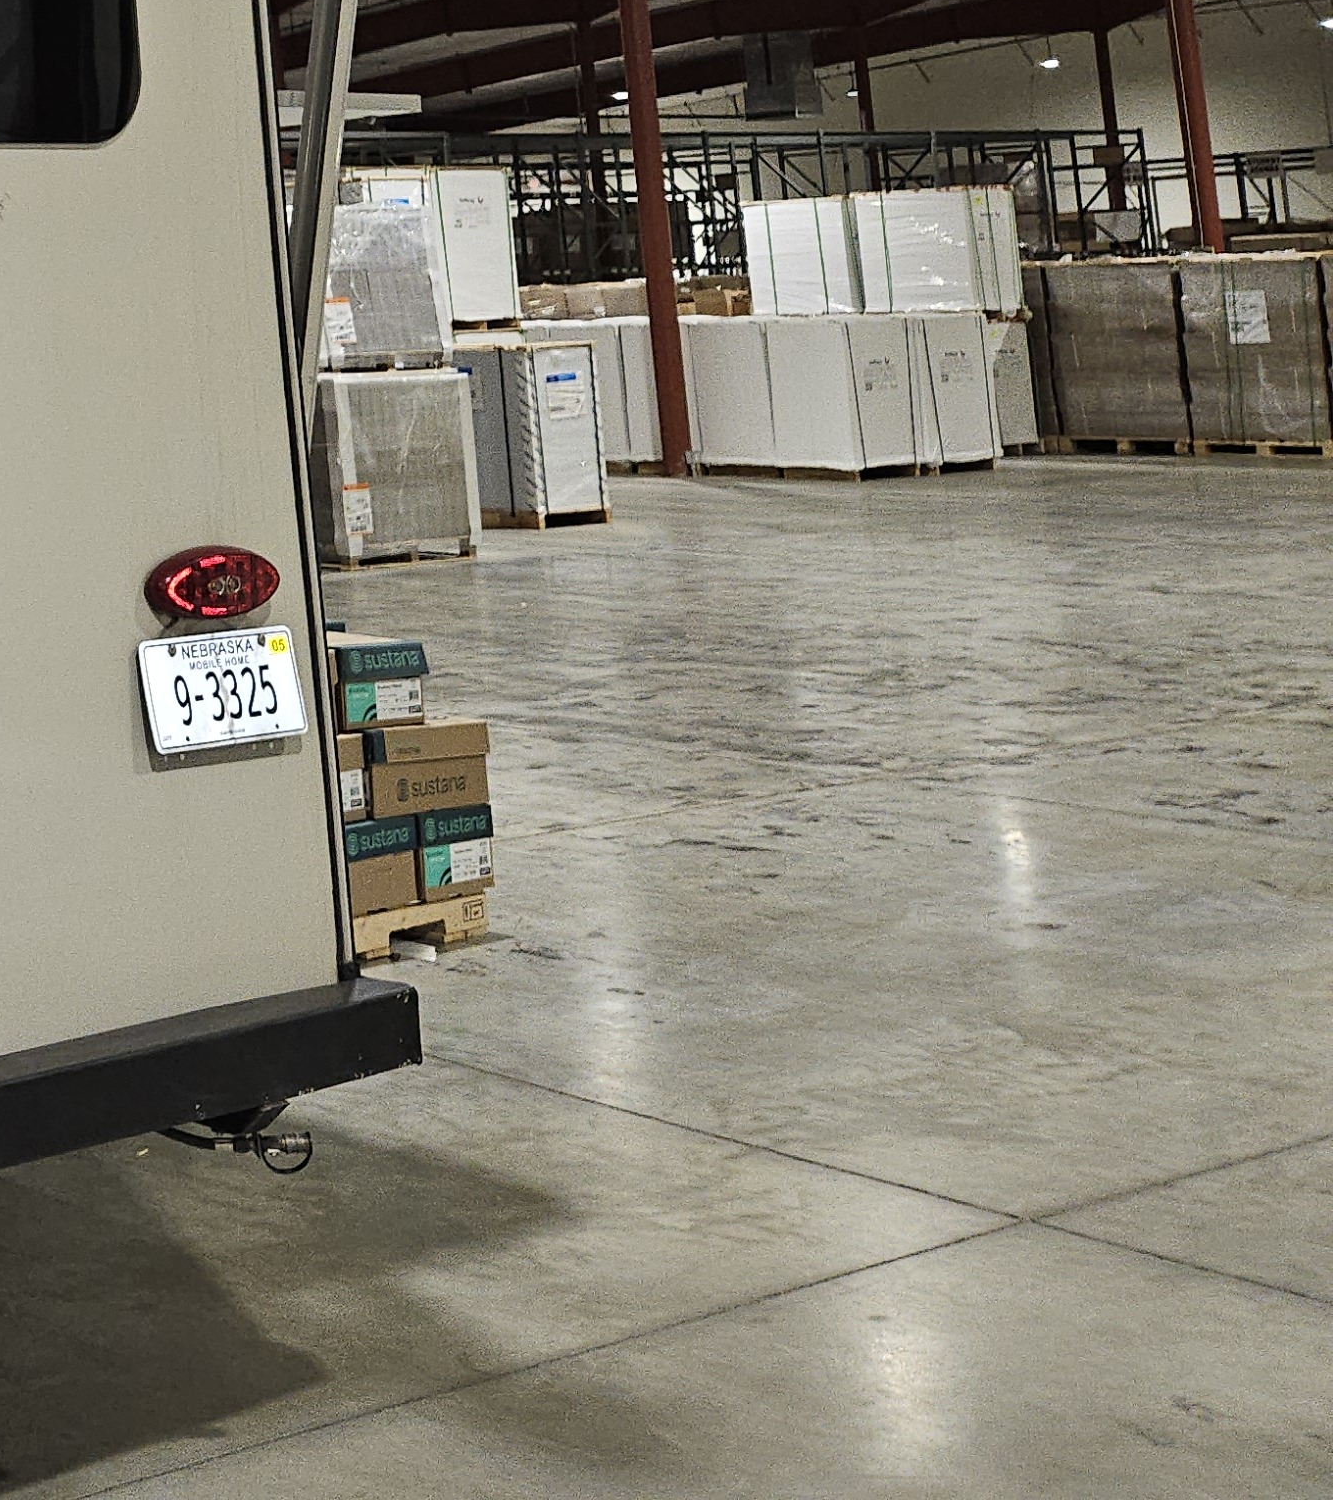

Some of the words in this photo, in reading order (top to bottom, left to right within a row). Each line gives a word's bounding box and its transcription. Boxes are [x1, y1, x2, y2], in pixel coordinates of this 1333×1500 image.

[181, 638, 254, 660] NEBRASKA
[271, 639, 286, 651] 05
[189, 658, 223, 671] MOBILE
[225, 655, 250, 667] HOME
[364, 649, 420, 670] sustana
[174, 665, 278, 726] 9-3325
[411, 775, 466, 797] sustana
[437, 813, 489, 837] sustana
[359, 825, 409, 850] sustana
